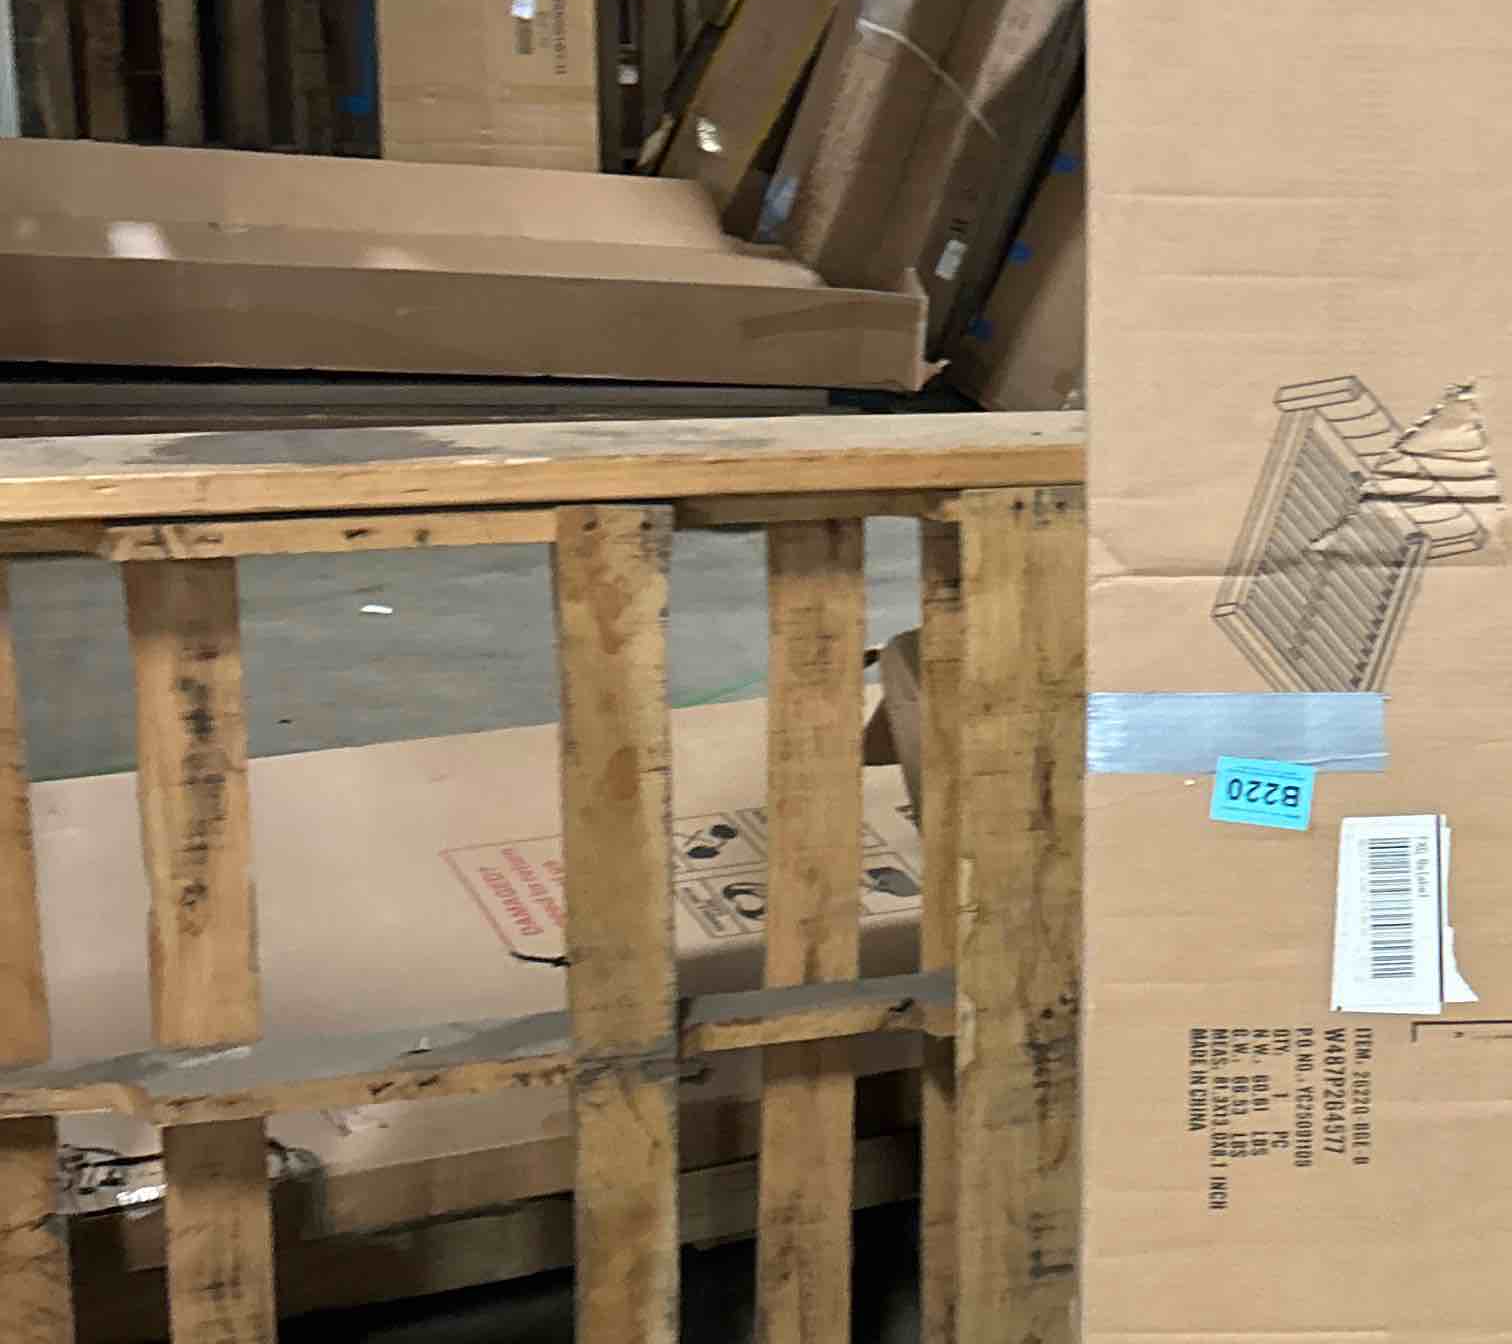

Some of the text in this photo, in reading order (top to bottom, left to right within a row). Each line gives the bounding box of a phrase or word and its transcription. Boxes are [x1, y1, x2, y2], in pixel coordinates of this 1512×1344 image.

[1226, 777, 1301, 808] B220
[1188, 1027, 1209, 1132] MADE IN CHINA
[1271, 1131, 1289, 1149] PC
[1208, 1176, 1229, 1210] INCH
